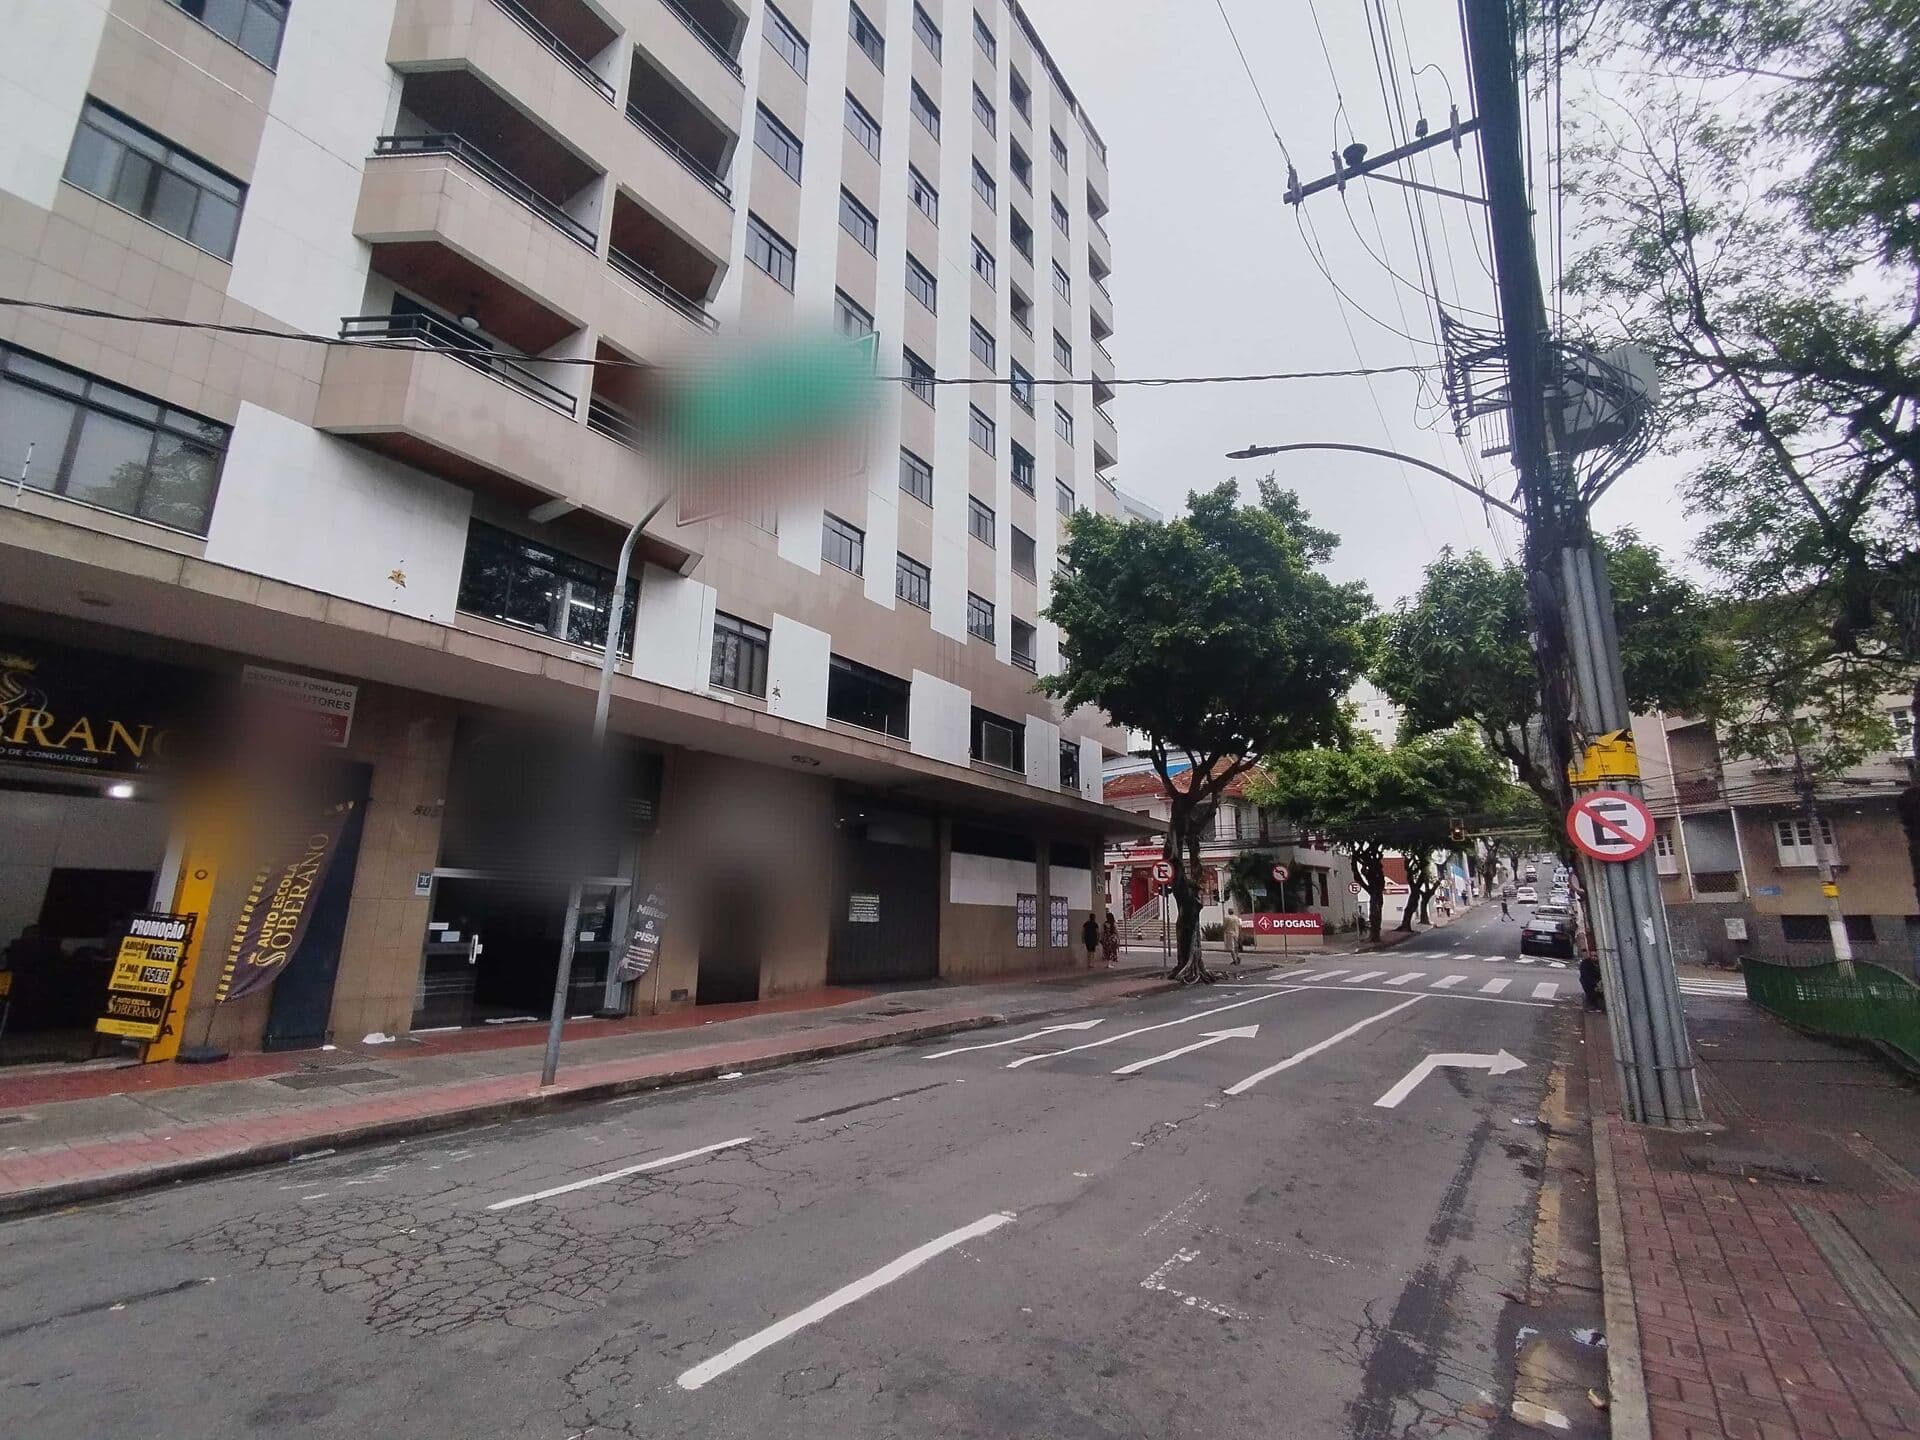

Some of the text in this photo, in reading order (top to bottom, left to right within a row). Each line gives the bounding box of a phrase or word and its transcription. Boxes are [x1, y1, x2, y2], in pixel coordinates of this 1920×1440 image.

[303, 682, 354, 698] FORMAÇÃO
[8, 748, 23, 756] DE
[26, 750, 98, 764] CONDUTORES
[1589, 803, 1630, 845] E
[1157, 864, 1168, 878] E
[255, 833, 328, 967] SOBERANO
[257, 863, 300, 948] AUTO ESCOLA
[130, 919, 186, 940] PROMOÇÃO
[107, 998, 160, 1018] SOBERANO
